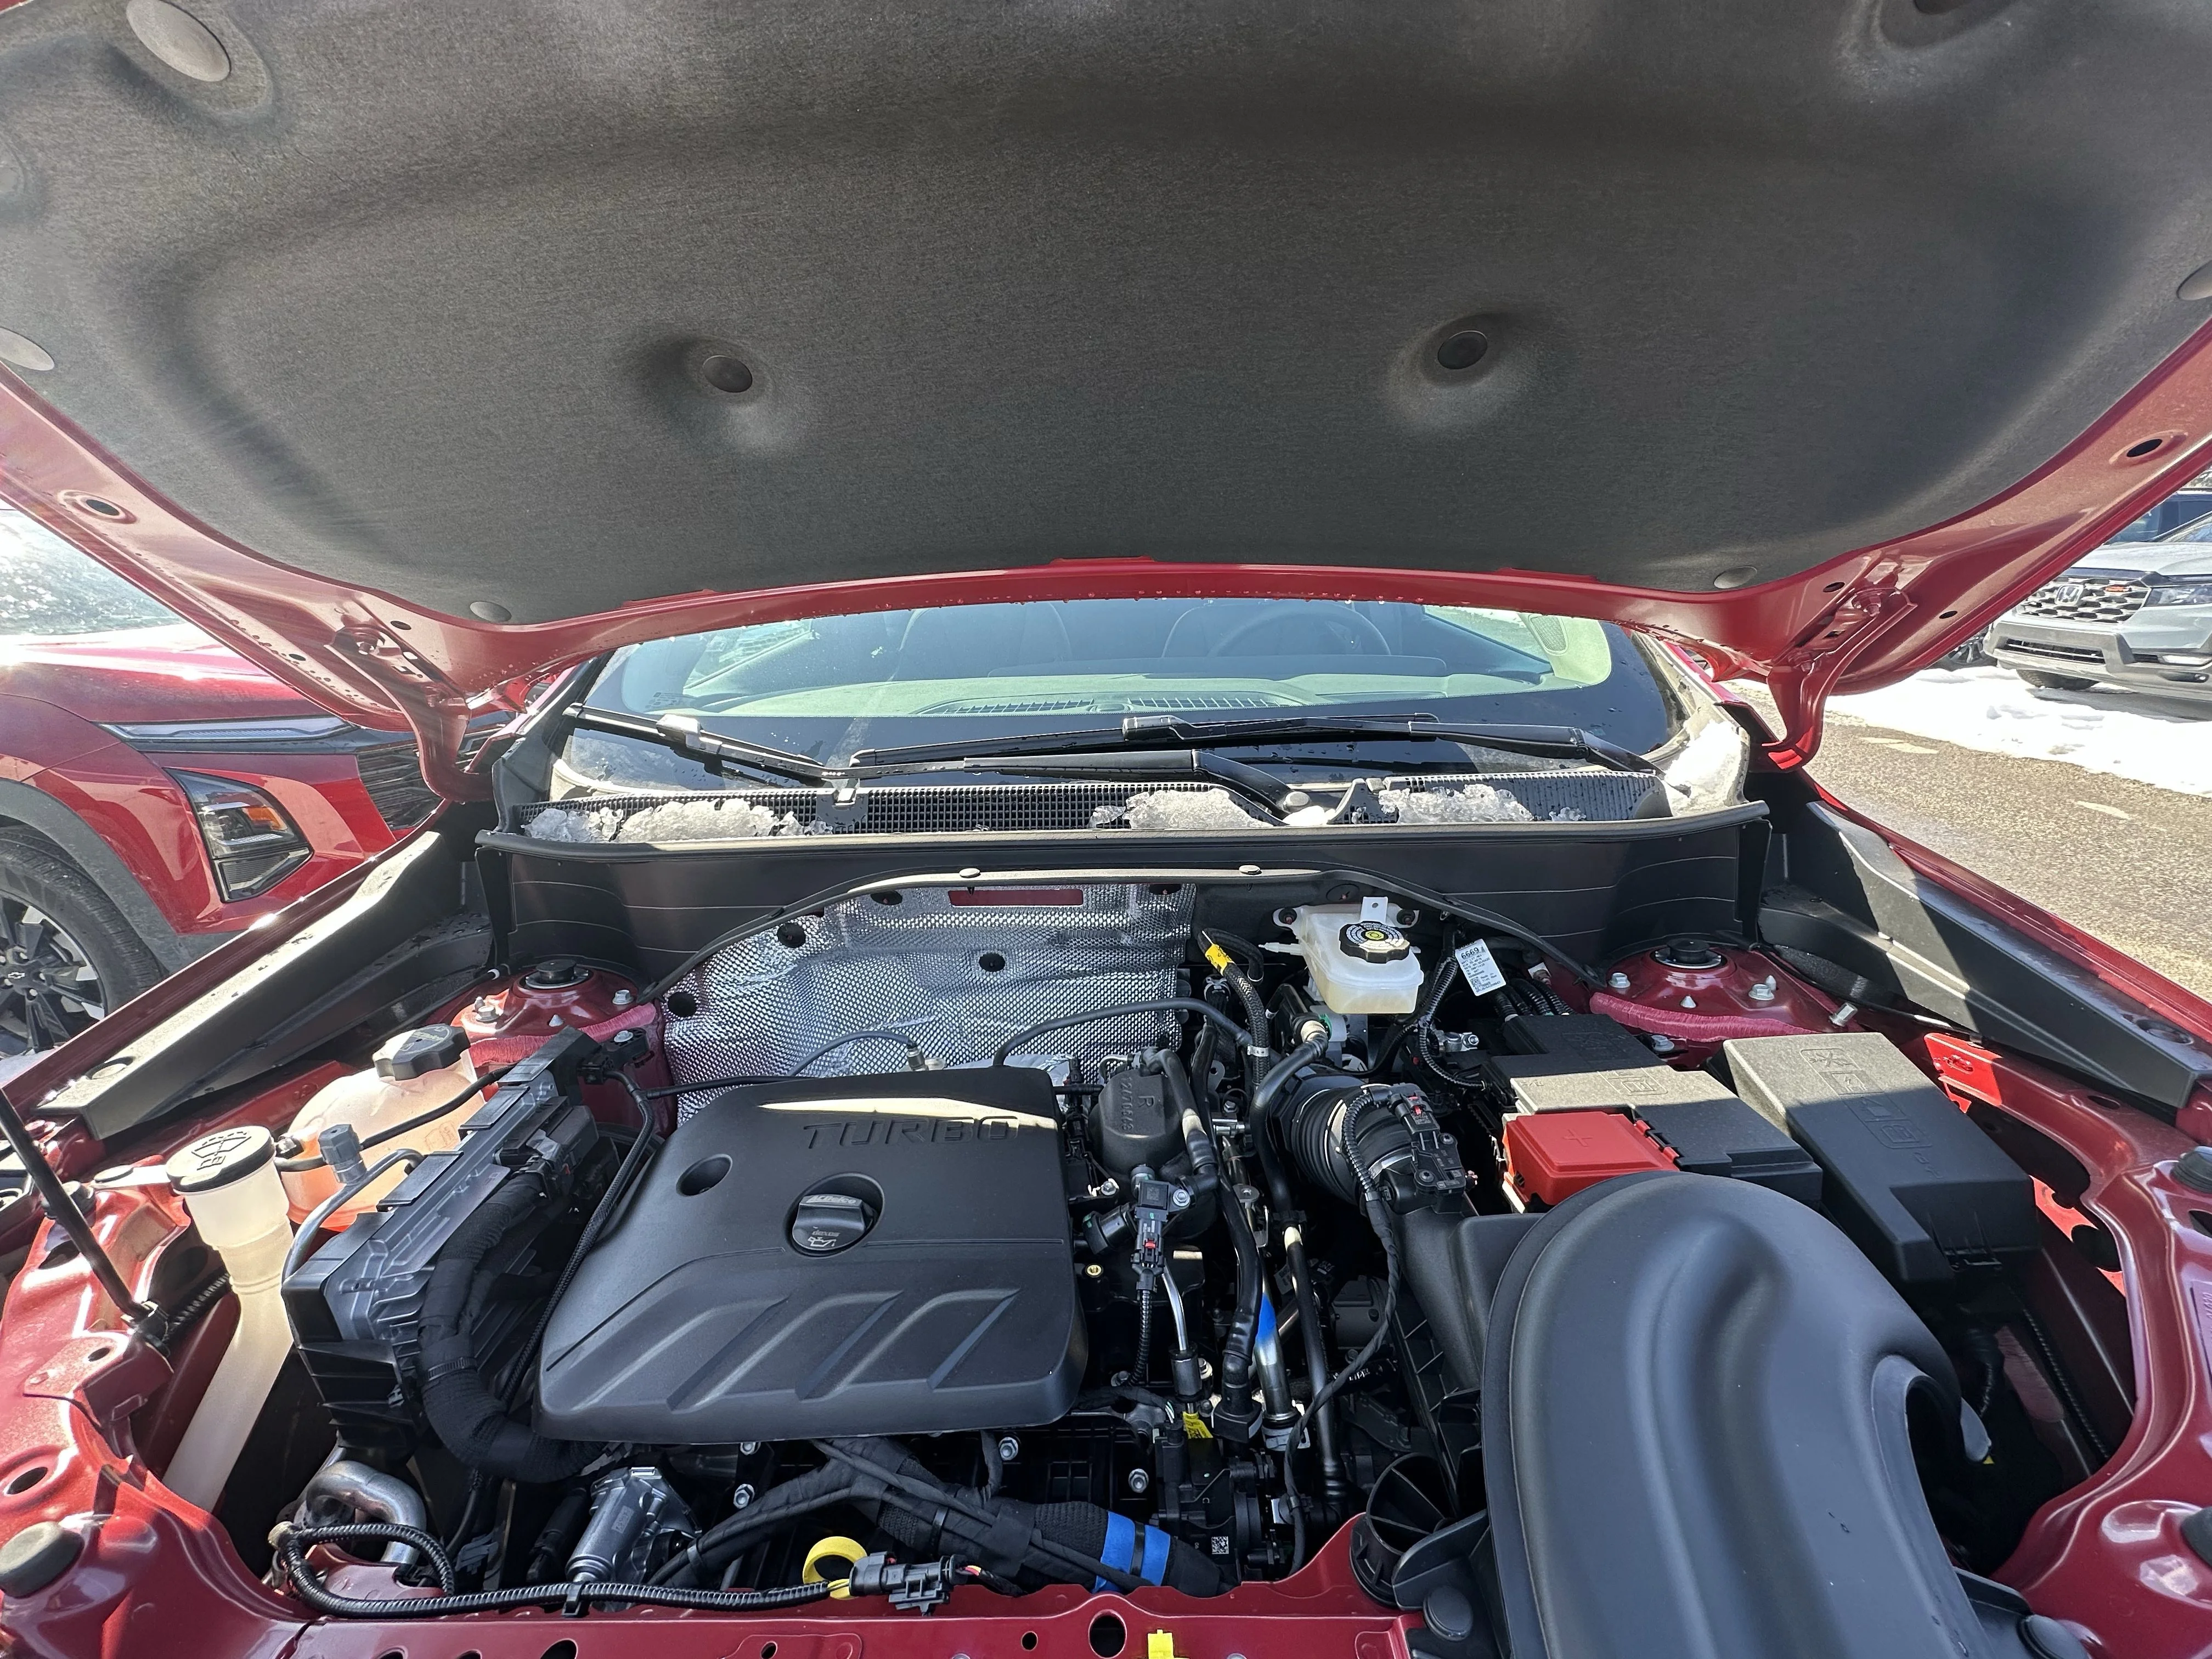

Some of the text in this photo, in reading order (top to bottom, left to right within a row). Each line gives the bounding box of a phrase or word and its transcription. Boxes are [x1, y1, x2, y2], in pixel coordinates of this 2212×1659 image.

[1461, 947, 1479, 959] 6669
[1138, 1095, 1155, 1108] R
[804, 1115, 1019, 1149] TURBO
[806, 1195, 856, 1204] ACDelco
